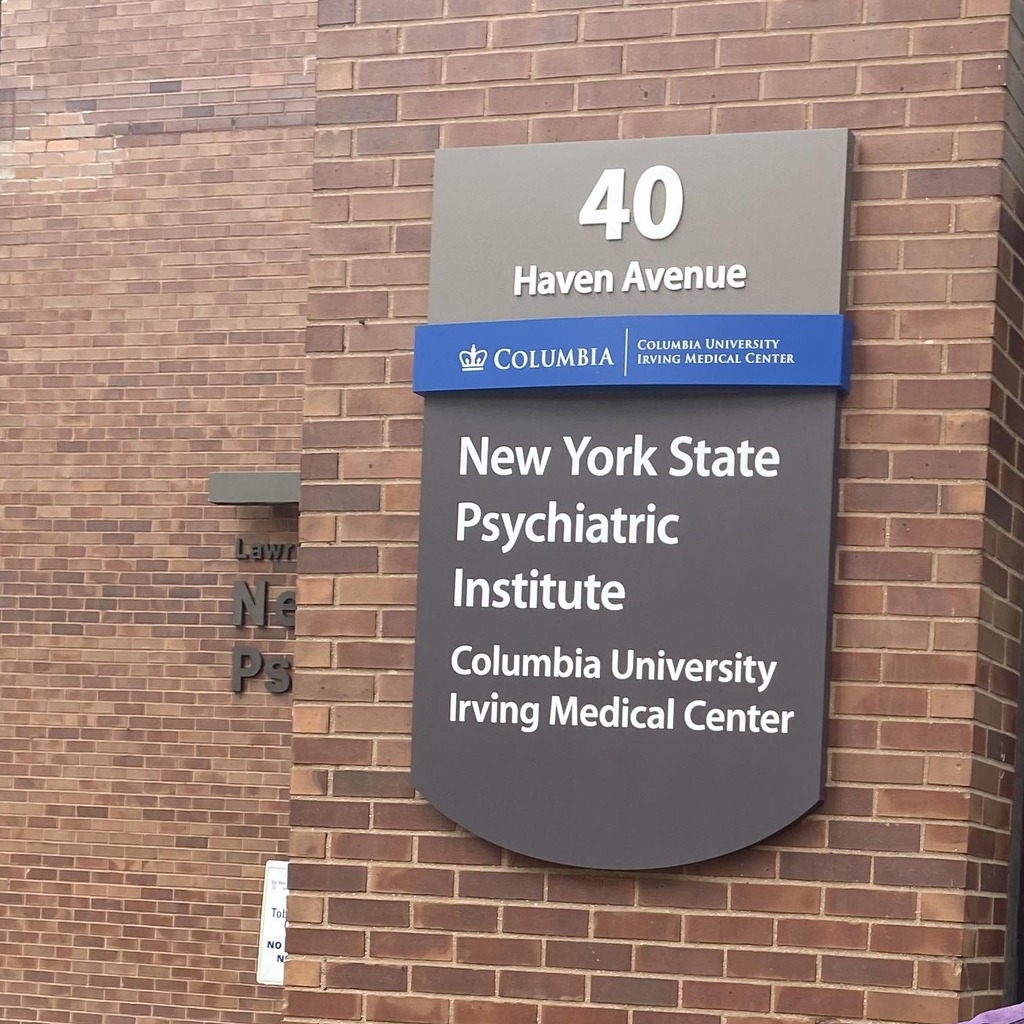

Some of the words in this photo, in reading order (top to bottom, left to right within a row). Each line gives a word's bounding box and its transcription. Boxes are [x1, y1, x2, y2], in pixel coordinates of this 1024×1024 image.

[578, 164, 684, 241] 40
[513, 264, 614, 296] Haven
[621, 260, 747, 292] Avenue
[493, 346, 615, 370] COLUMBIA
[637, 338, 701, 351] COLUMBIA
[705, 337, 780, 350] UNIVERSITY
[637, 353, 681, 365] IRVING
[684, 352, 741, 365] MEDICAL
[745, 352, 795, 365] CENTER
[458, 435, 552, 476] New
[562, 433, 659, 477] York
[668, 434, 780, 478] State
[456, 500, 680, 553] Psychiatric
[236, 538, 295, 560] Lawr
[233, 580, 297, 627] Ne
[453, 568, 626, 611] Institute
[232, 645, 293, 694] Ps
[450, 644, 601, 679] Columbia
[611, 649, 777, 692] University
[448, 692, 540, 732] Irving
[549, 695, 675, 730] Medical
[683, 699, 795, 734] Center
[266, 941, 281, 950] NO
